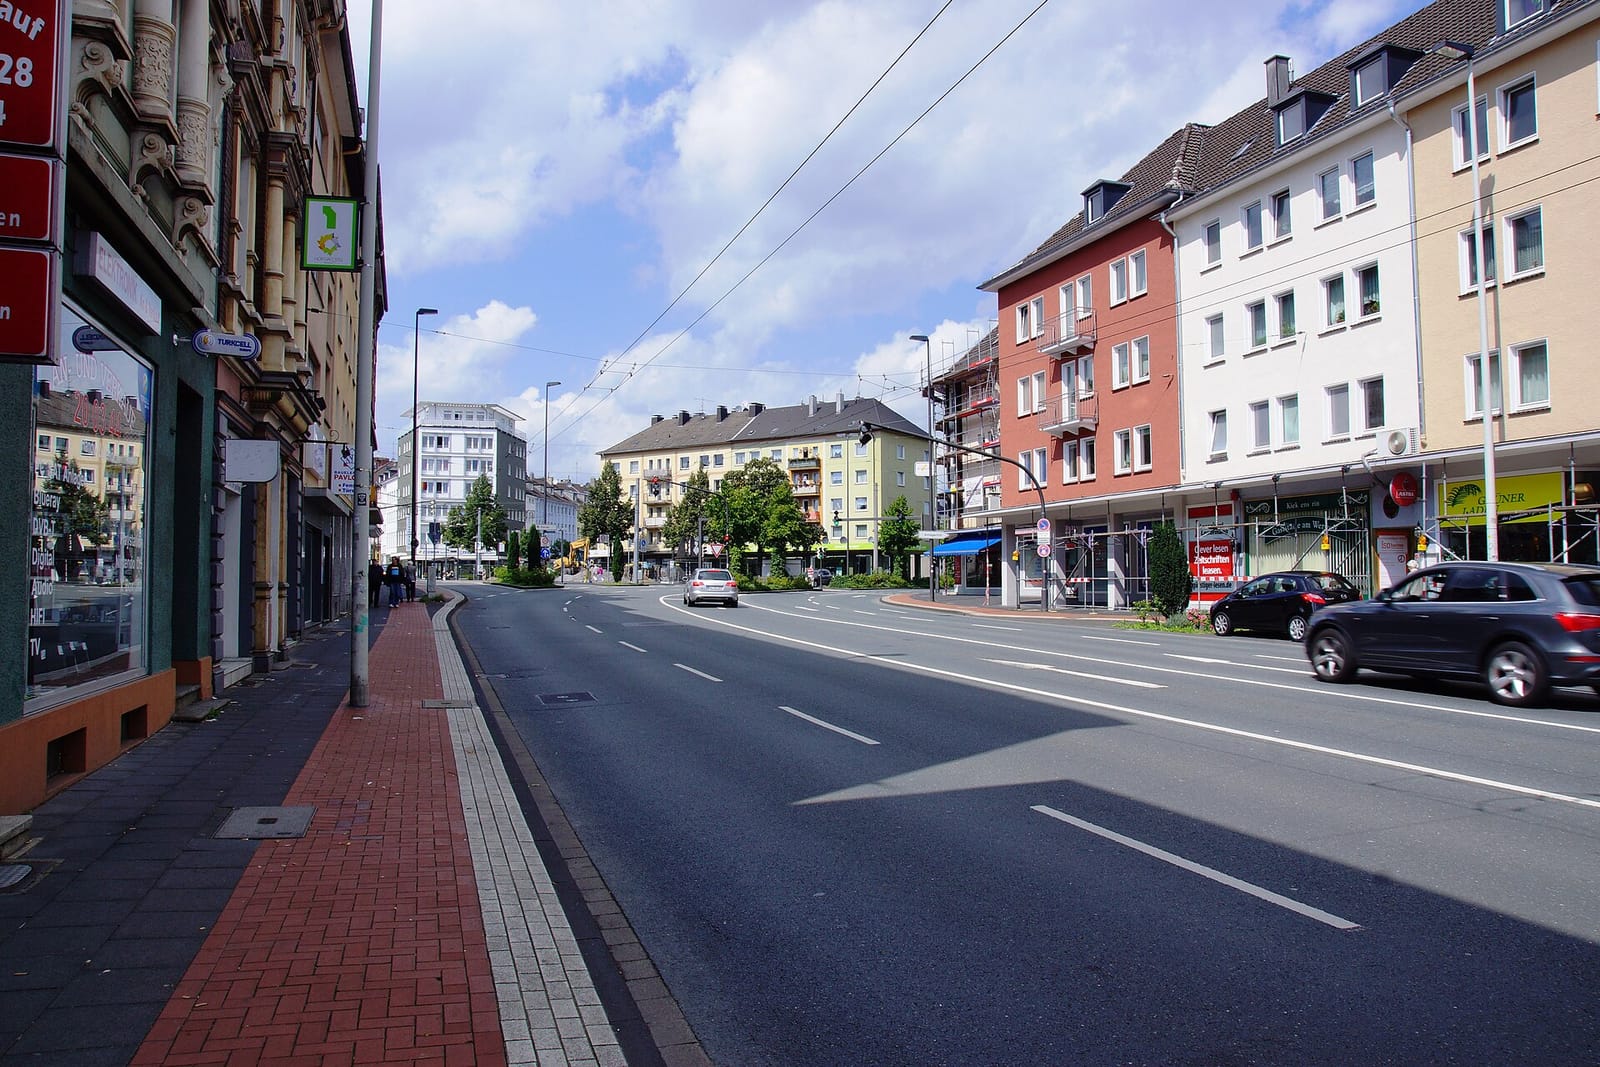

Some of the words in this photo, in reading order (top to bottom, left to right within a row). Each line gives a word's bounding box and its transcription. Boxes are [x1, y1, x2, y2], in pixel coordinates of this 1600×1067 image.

[218, 338, 252, 348] TURKCELL
[33, 488, 61, 513] Blueray
[1213, 545, 1228, 553] lesen
[31, 547, 55, 570] Digital
[31, 578, 54, 595] Audio
